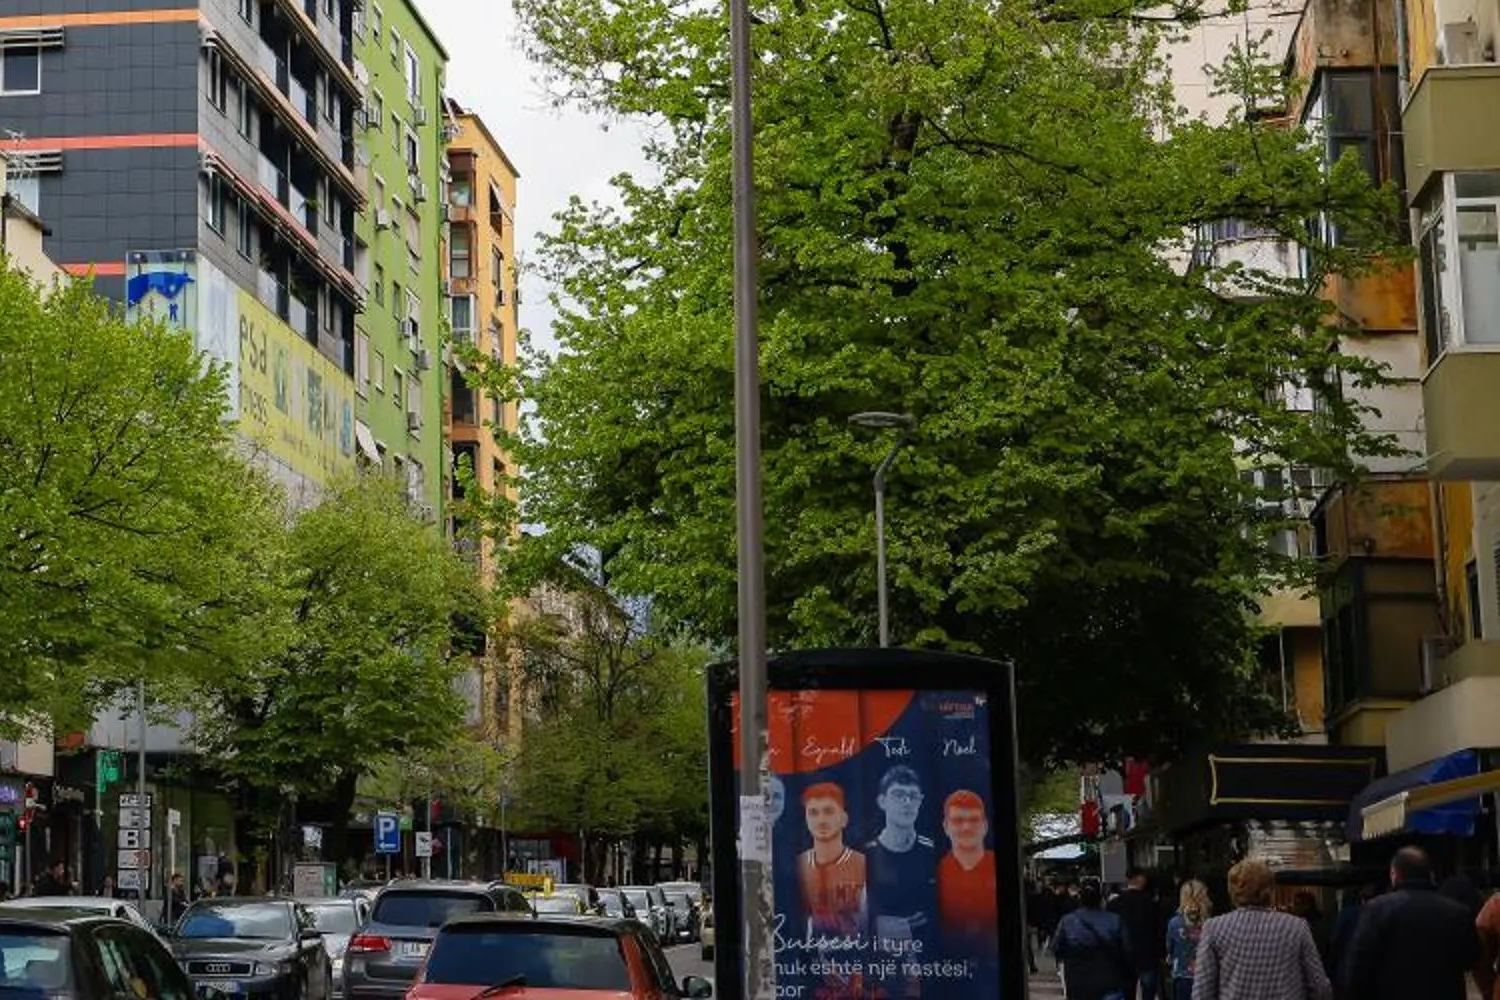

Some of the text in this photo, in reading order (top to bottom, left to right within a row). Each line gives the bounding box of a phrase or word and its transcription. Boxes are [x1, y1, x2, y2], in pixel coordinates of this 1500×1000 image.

[379, 816, 397, 841] P
[883, 937, 924, 957] tyre
[810, 957, 864, 976] është
[867, 959, 897, 981] një
